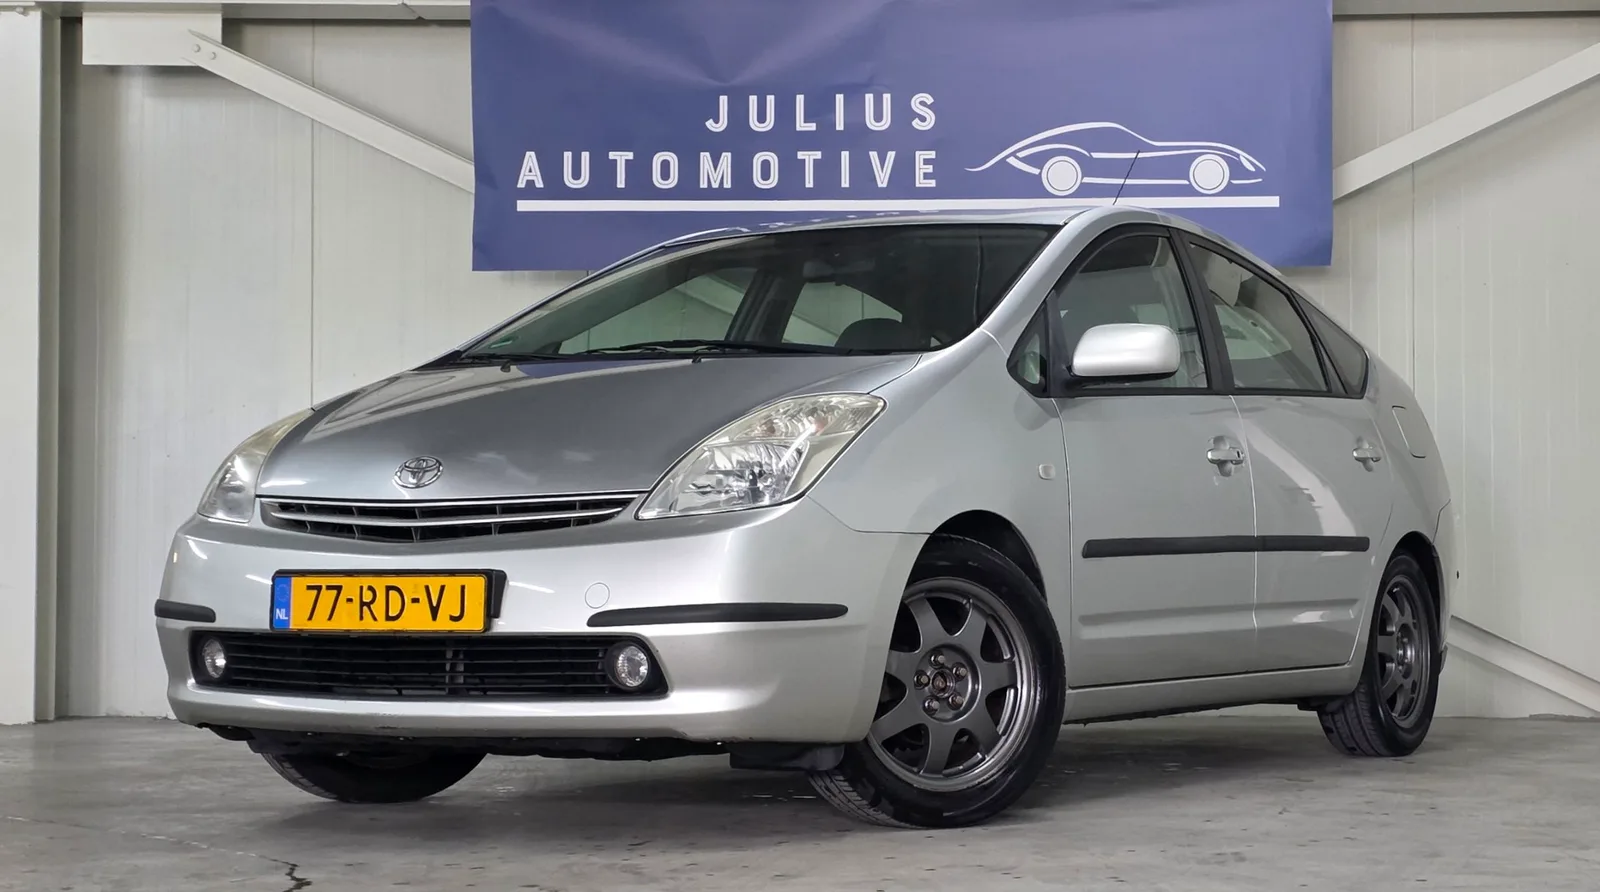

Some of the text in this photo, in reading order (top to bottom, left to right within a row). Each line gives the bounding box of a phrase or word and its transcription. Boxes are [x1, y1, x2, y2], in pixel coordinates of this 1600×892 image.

[704, 92, 936, 133] JULIUS
[516, 150, 938, 189] AUTOMOTIVE
[275, 608, 289, 620] NL
[305, 583, 467, 623] 77-RD-VJ
